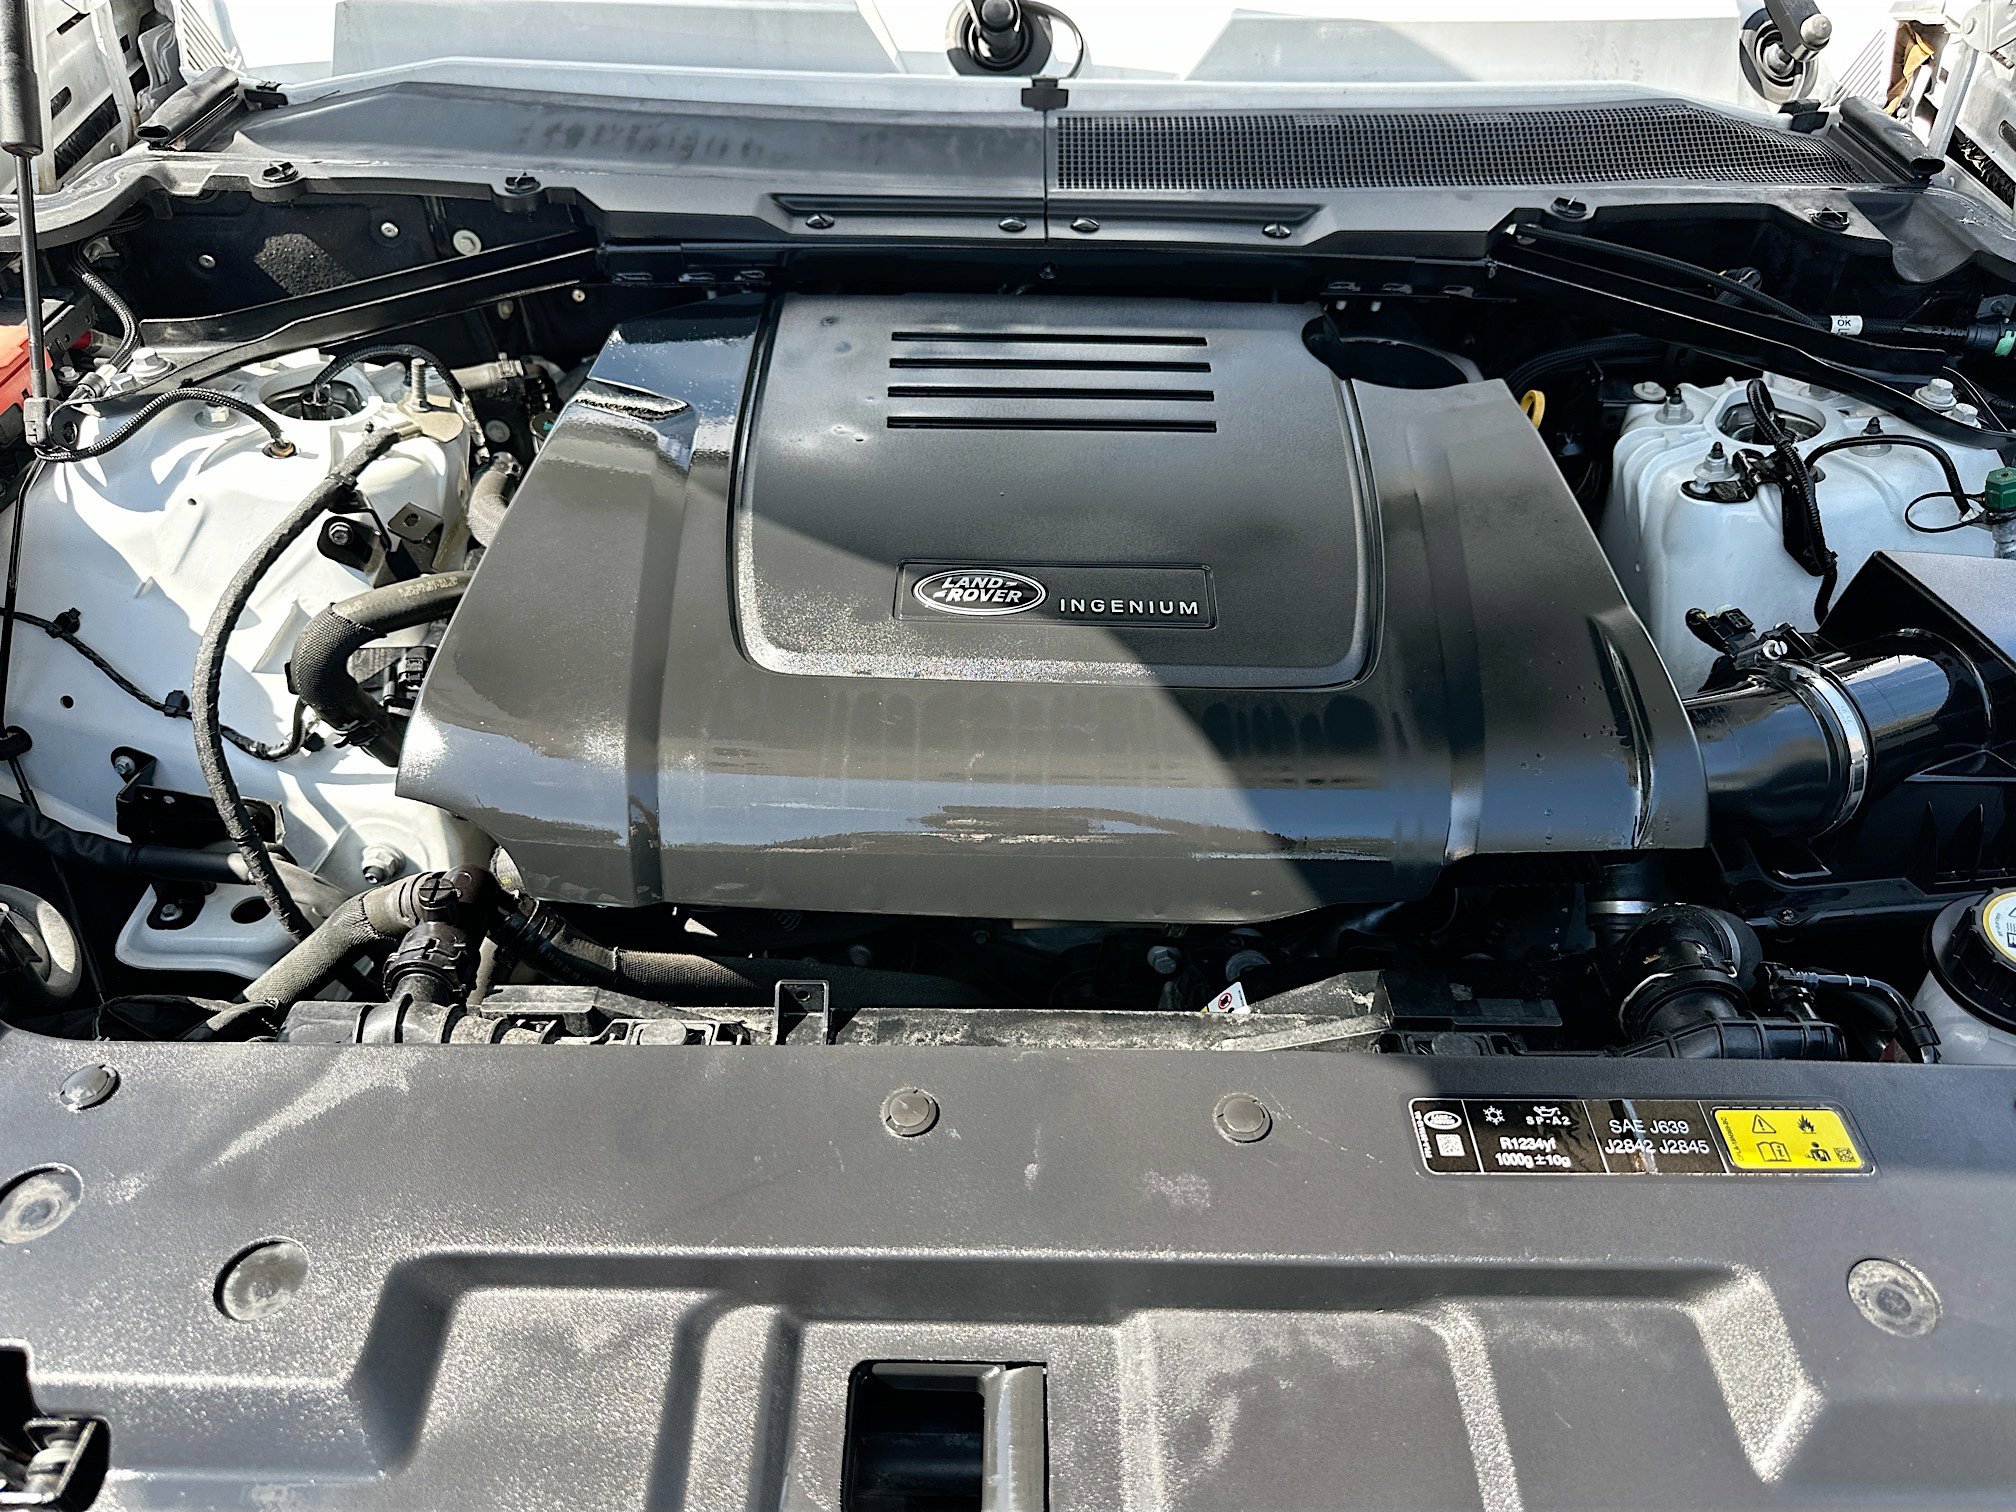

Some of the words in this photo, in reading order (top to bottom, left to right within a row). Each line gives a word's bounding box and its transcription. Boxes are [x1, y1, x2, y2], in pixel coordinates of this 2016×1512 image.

[1837, 319, 1851, 327] OK
[941, 577, 1003, 589] LAND
[945, 588, 1023, 603] ROVER
[1059, 598, 1199, 615] INGENIUM
[1525, 1115, 1572, 1126] SP-A2
[1608, 1118, 1647, 1134] SAE
[1649, 1119, 1690, 1134] J639
[1500, 1136, 1557, 1153] R1234yf
[1604, 1138, 1657, 1154] J2842
[1658, 1139, 1710, 1155] J2845
